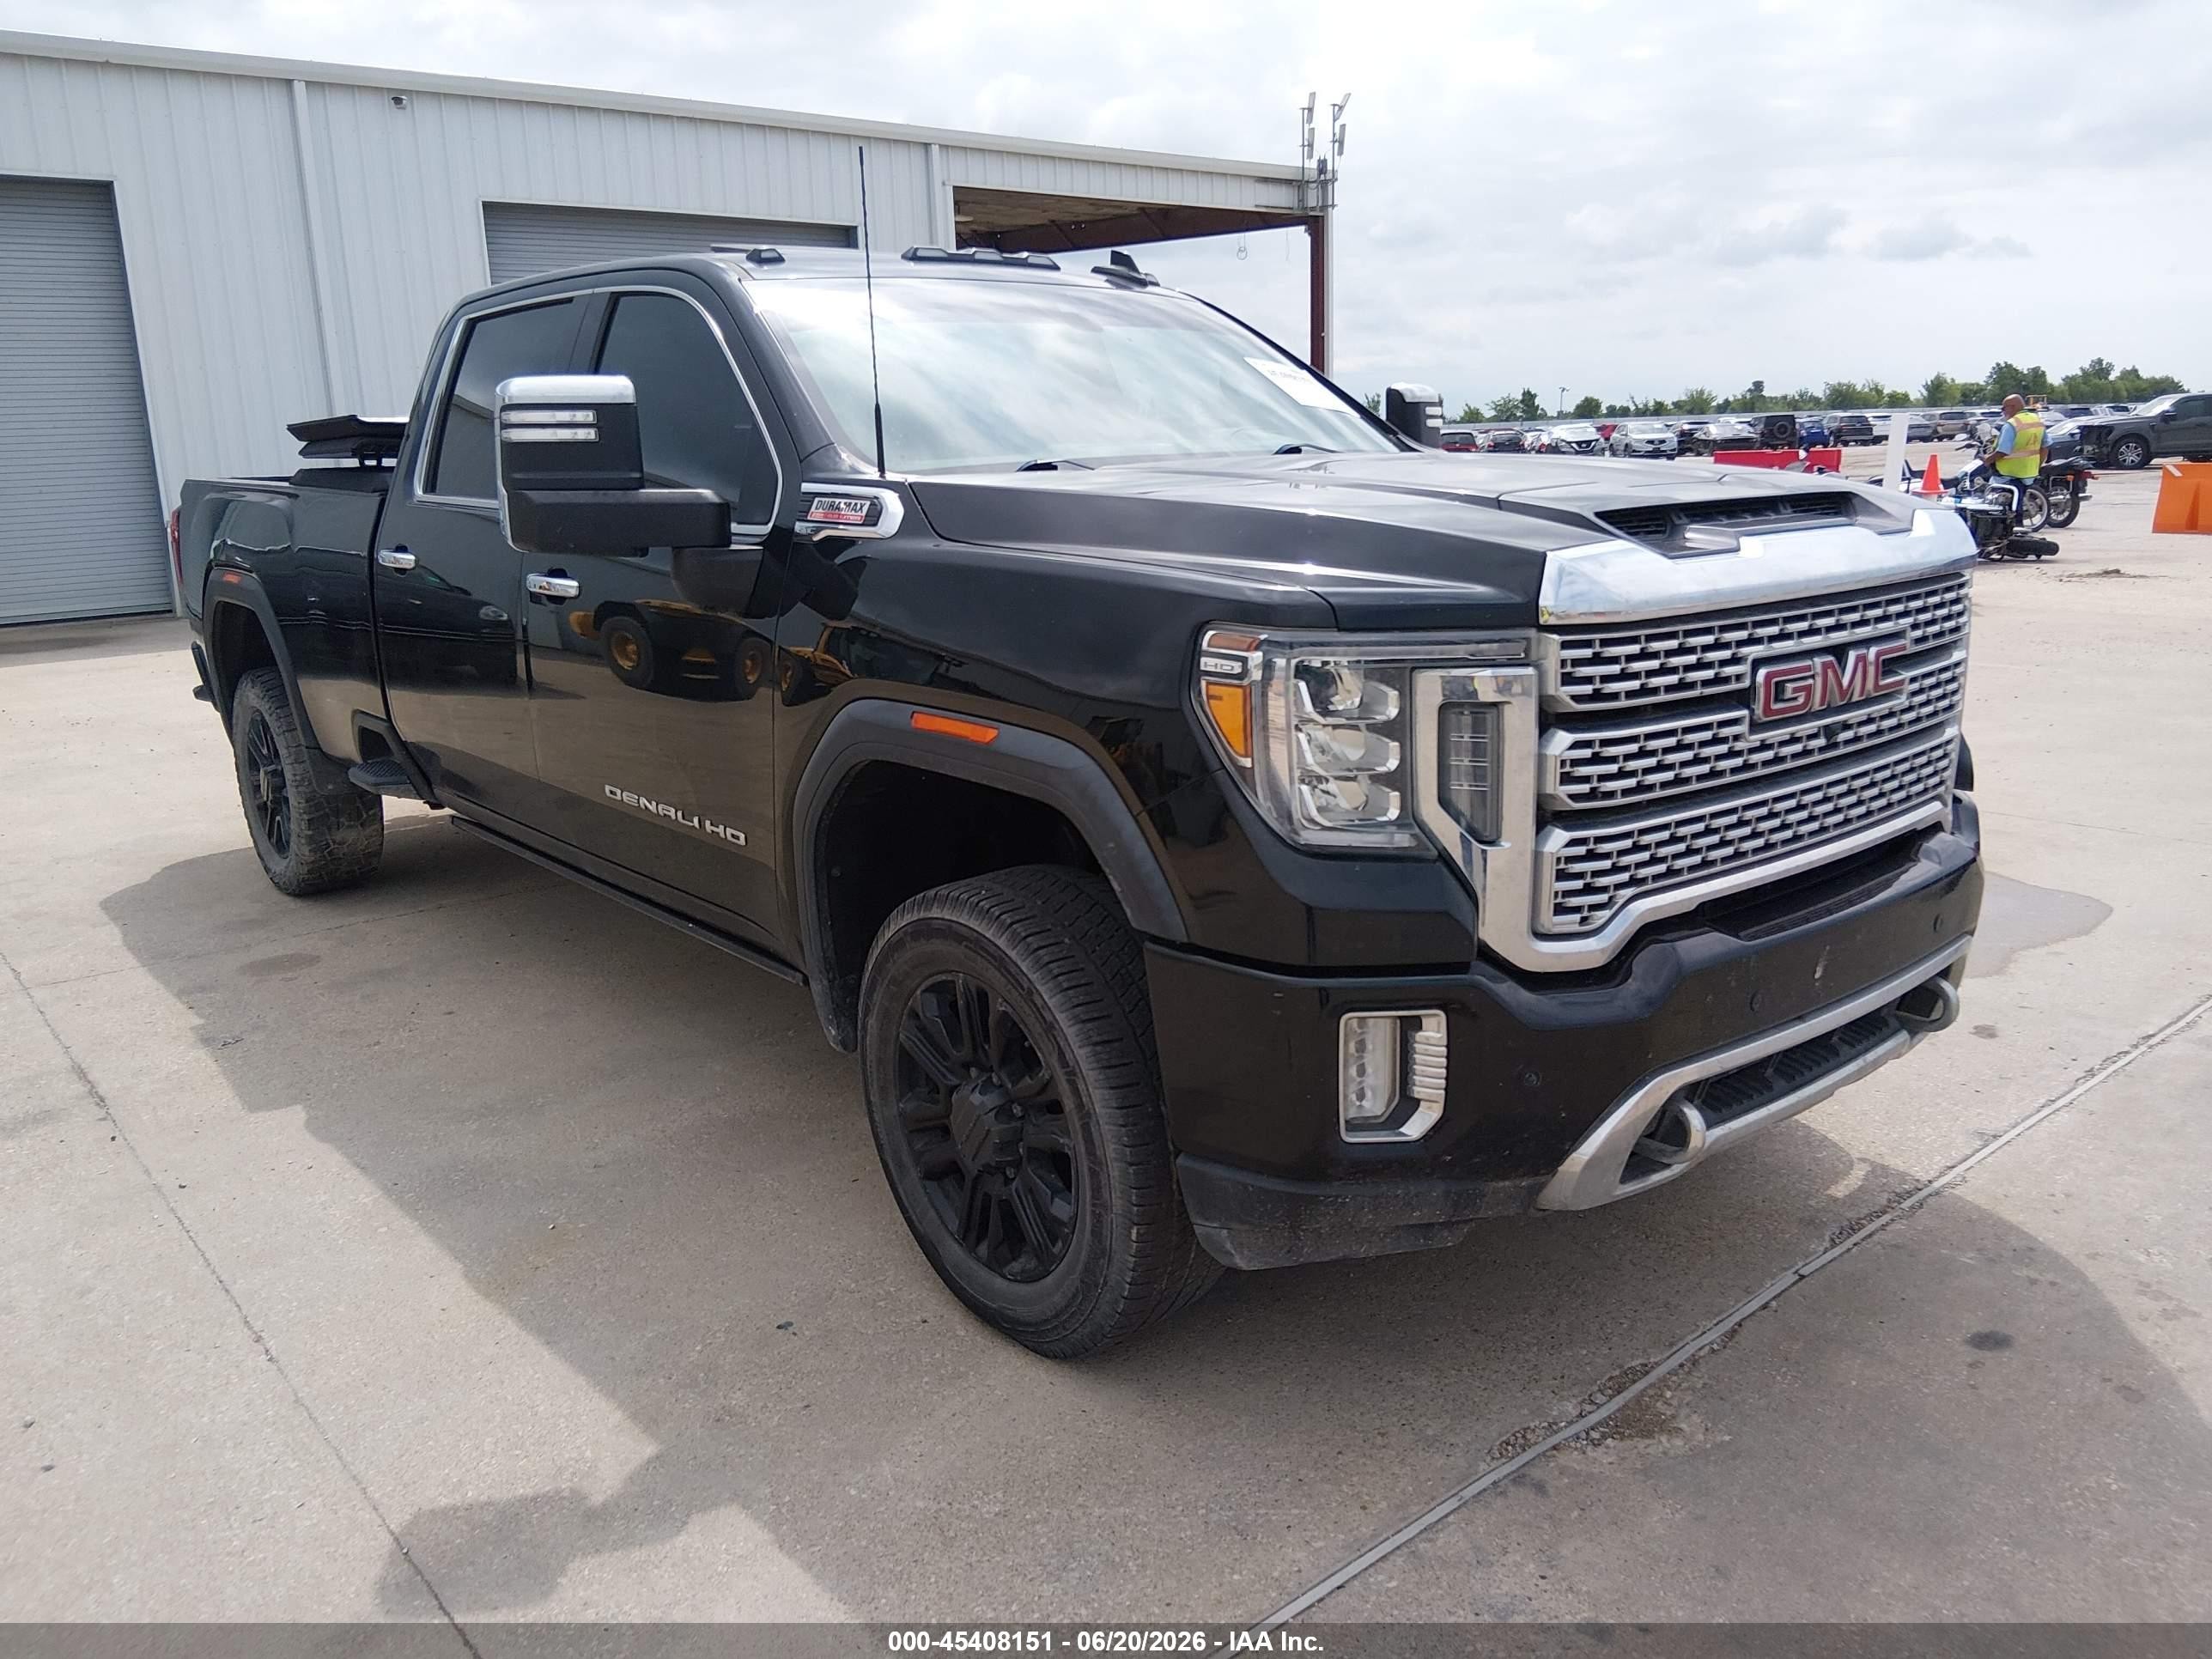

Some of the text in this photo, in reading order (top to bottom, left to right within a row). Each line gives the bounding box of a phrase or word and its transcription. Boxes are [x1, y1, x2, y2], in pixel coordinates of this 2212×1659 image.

[815, 500, 866, 514] DURAMAX
[1204, 661, 1235, 672] HD
[1757, 642, 1909, 721] GMC
[605, 784, 748, 846] DENALI HD
